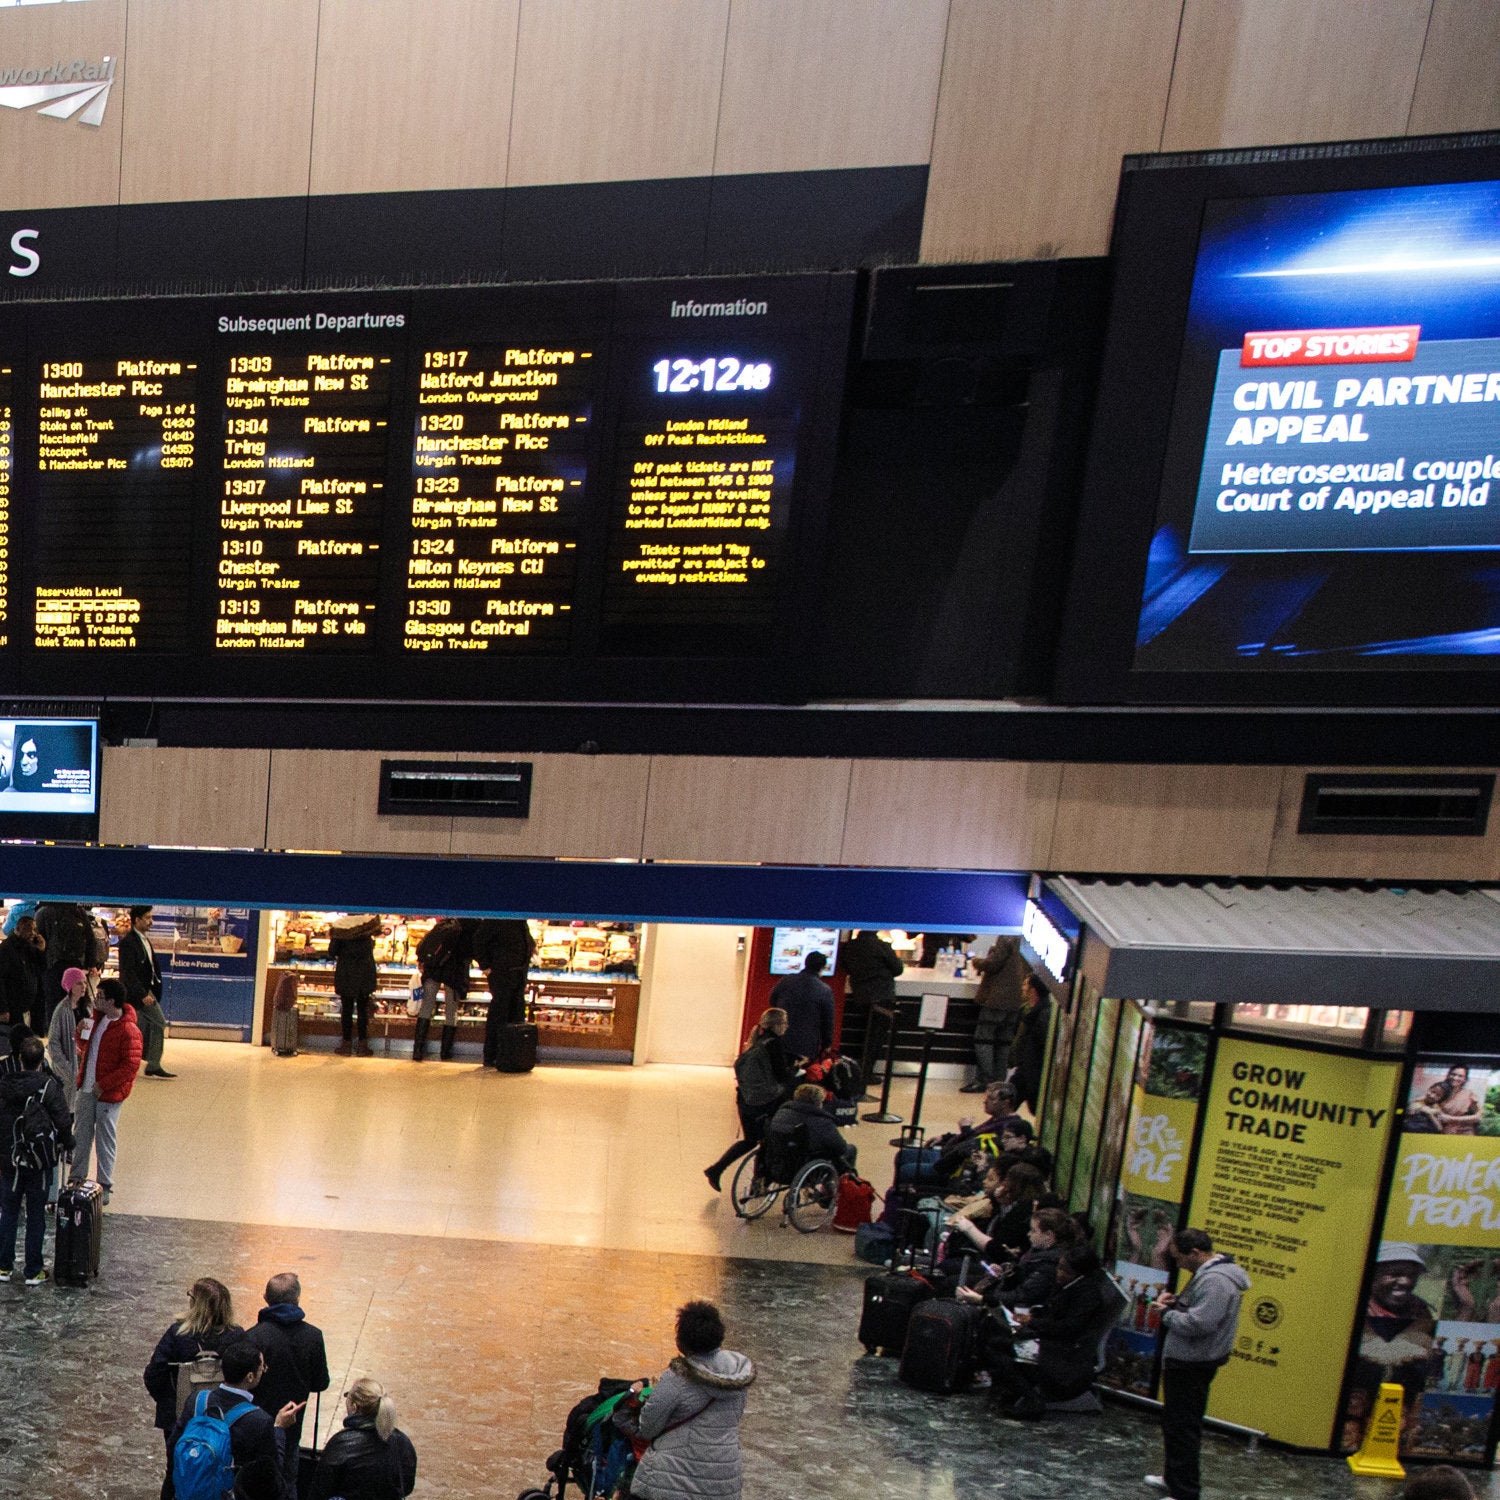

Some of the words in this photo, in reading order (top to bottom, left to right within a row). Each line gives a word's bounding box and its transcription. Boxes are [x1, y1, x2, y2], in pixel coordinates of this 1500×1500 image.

[671, 300, 767, 318] Information
[218, 314, 311, 334] Subsequent
[316, 313, 405, 332] Departures
[1250, 338, 1302, 360] TOP
[1304, 332, 1410, 358] STORIES
[231, 357, 272, 373] 13:03
[308, 355, 374, 370] Platform
[425, 351, 468, 367] 13:17
[505, 349, 574, 366] Platform
[227, 377, 308, 394] Birmingham
[314, 376, 344, 391] New
[351, 374, 368, 390] St
[421, 372, 484, 388] Watford
[490, 370, 557, 387] Junction
[226, 397, 265, 409] Virgin
[270, 396, 309, 406] Trains
[420, 393, 462, 404] London
[467, 390, 539, 404] Overground
[1232, 381, 1323, 411] CIVIL
[666, 420, 704, 432] London
[708, 419, 748, 430] Midland
[1226, 415, 1370, 445] APPEAL
[645, 434, 665, 446] Off
[668, 434, 694, 444] Peak
[697, 433, 766, 444] Restrictions.
[40, 447, 87, 458] Stockport
[1221, 458, 1404, 486] Heterosexual
[1216, 486, 1291, 513] Court
[1297, 482, 1329, 510] of
[1333, 483, 1435, 514] Appeal
[1443, 481, 1488, 507] bid
[221, 500, 291, 516] Liverpool
[297, 499, 329, 514] Lime
[335, 499, 353, 514] St
[219, 560, 280, 575] Chester
[1232, 1062, 1306, 1090] GROW
[1228, 1087, 1386, 1128] COMMUNITY
[1226, 1112, 1307, 1144] TRADE
